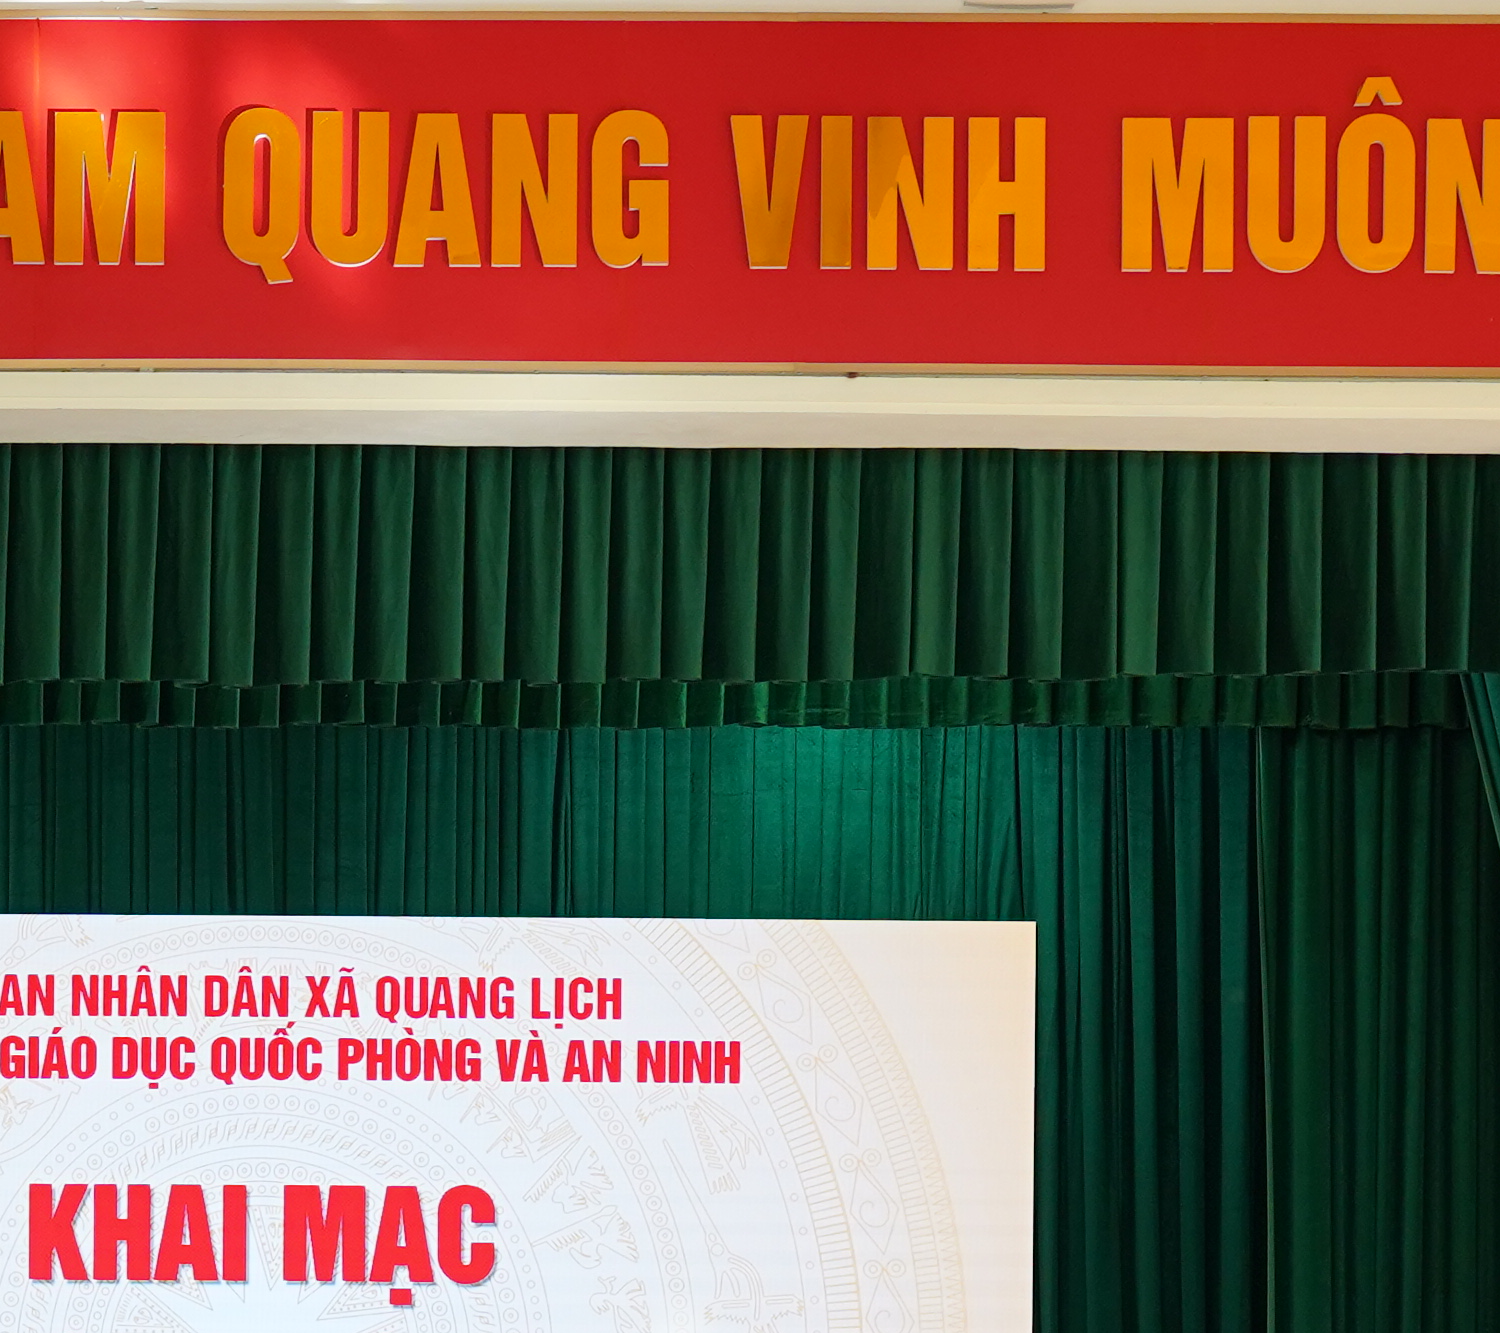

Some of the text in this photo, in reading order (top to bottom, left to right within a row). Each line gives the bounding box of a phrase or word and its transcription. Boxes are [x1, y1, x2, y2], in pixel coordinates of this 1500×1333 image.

[223, 108, 669, 283] QUANG
[731, 115, 1046, 271] VINH
[72, 965, 187, 1016] NHÂN
[204, 966, 289, 1017] DÂN
[305, 968, 360, 1018] XÃ
[376, 976, 514, 1023] QUANG
[531, 977, 622, 1029] LỊCH
[0, 1027, 97, 1079] GIÁO
[112, 1037, 195, 1089] DỤC
[211, 1021, 322, 1084] QUỐC
[338, 1027, 481, 1082] PHÒNG
[496, 1030, 549, 1082] VÀ
[562, 1040, 621, 1082] AN
[637, 1041, 741, 1084] NINH
[29, 1184, 495, 1305] KHAI MẠC
